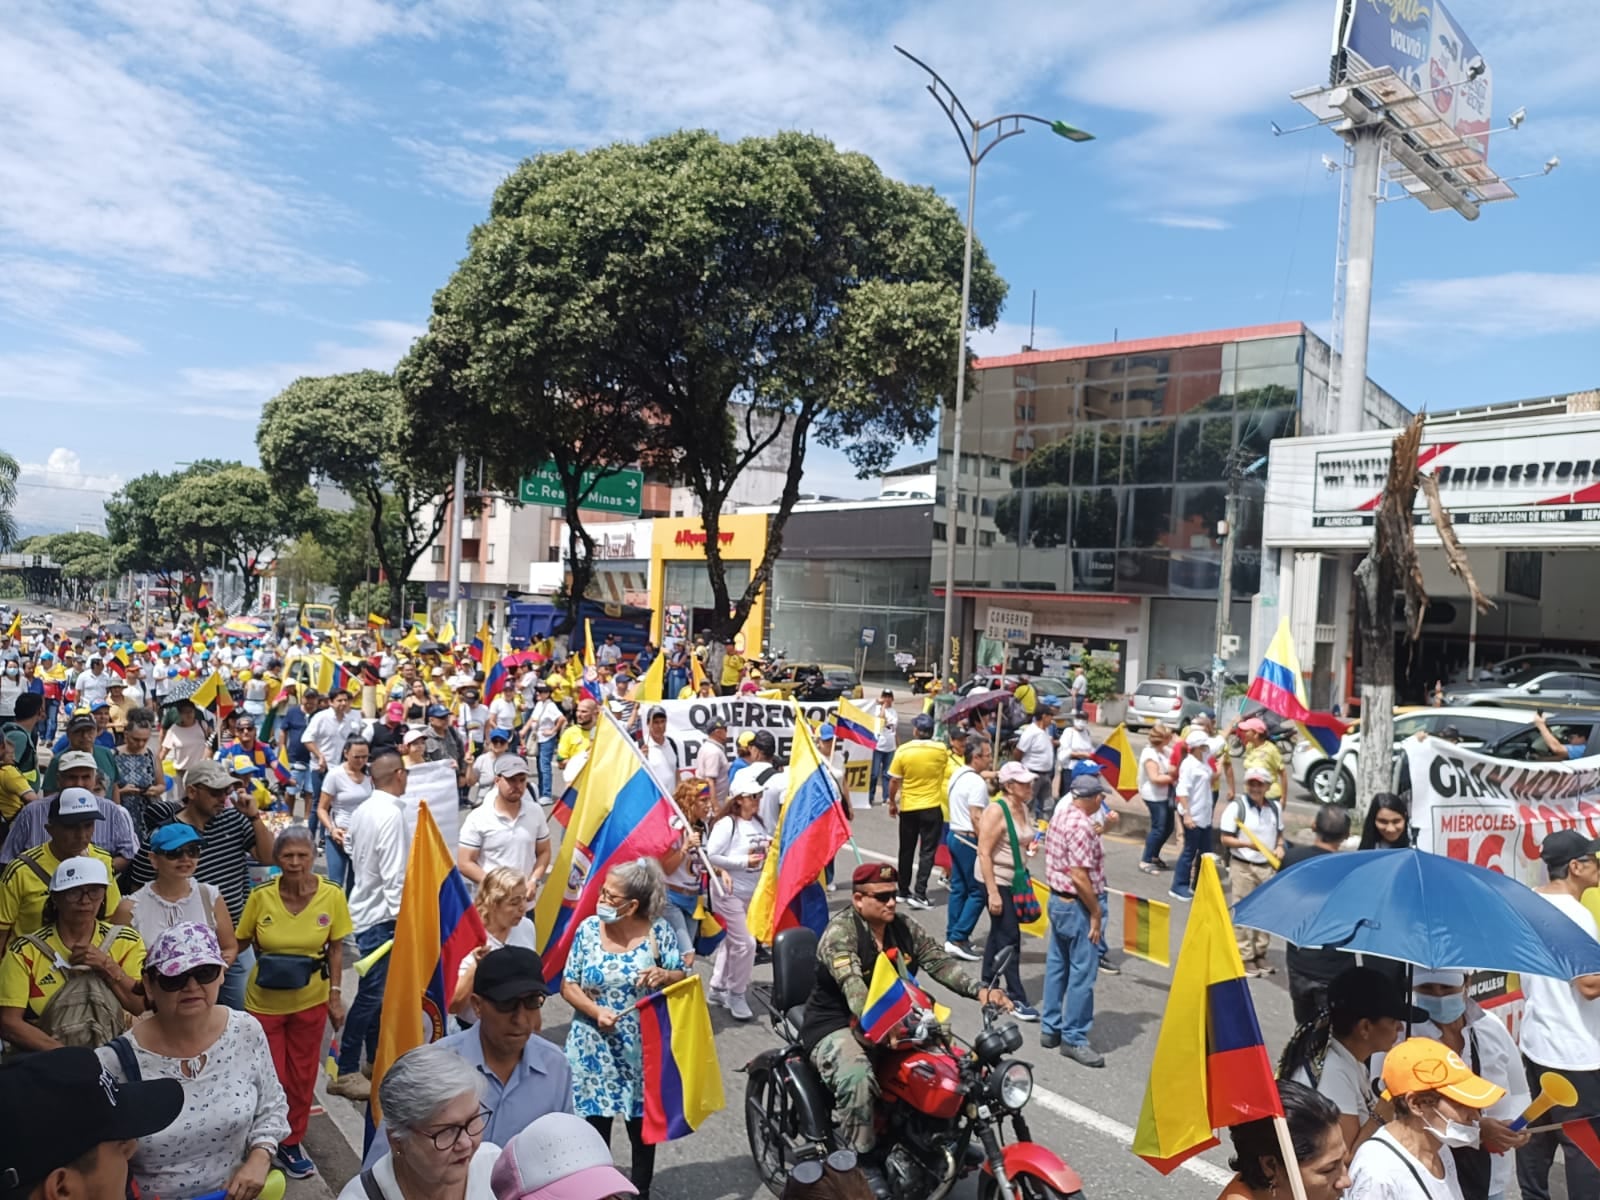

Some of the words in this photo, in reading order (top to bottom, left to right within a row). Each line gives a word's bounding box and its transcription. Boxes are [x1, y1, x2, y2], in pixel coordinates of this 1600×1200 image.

[525, 483, 539, 496] C.
[541, 484, 566, 500] Rea
[587, 491, 622, 506] Minas
[991, 611, 1028, 627] CONSERVE
[1430, 754, 1514, 800] GRAN
